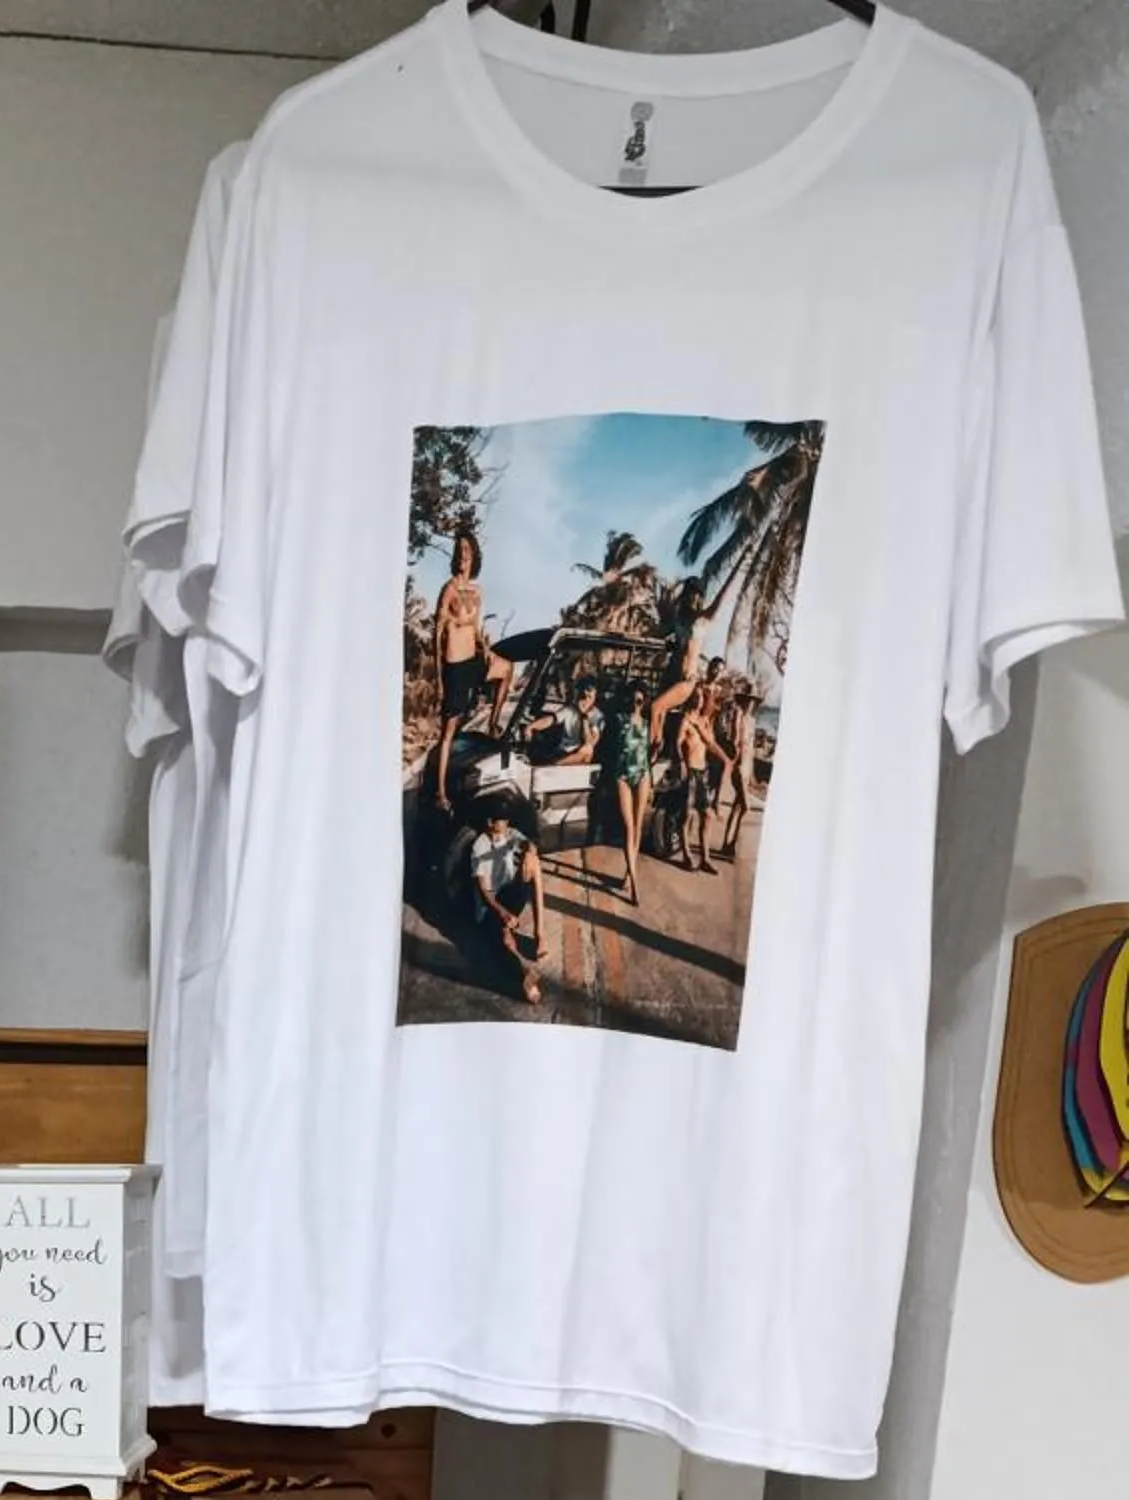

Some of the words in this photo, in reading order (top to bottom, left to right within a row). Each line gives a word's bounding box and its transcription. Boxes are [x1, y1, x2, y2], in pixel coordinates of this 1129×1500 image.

[3, 1195, 91, 1229] ALL
[45, 1237, 108, 1265] need
[28, 1273, 61, 1302] is
[1, 1364, 61, 1394] and
[70, 1375, 89, 1393] a
[7, 1404, 86, 1437] DOG
